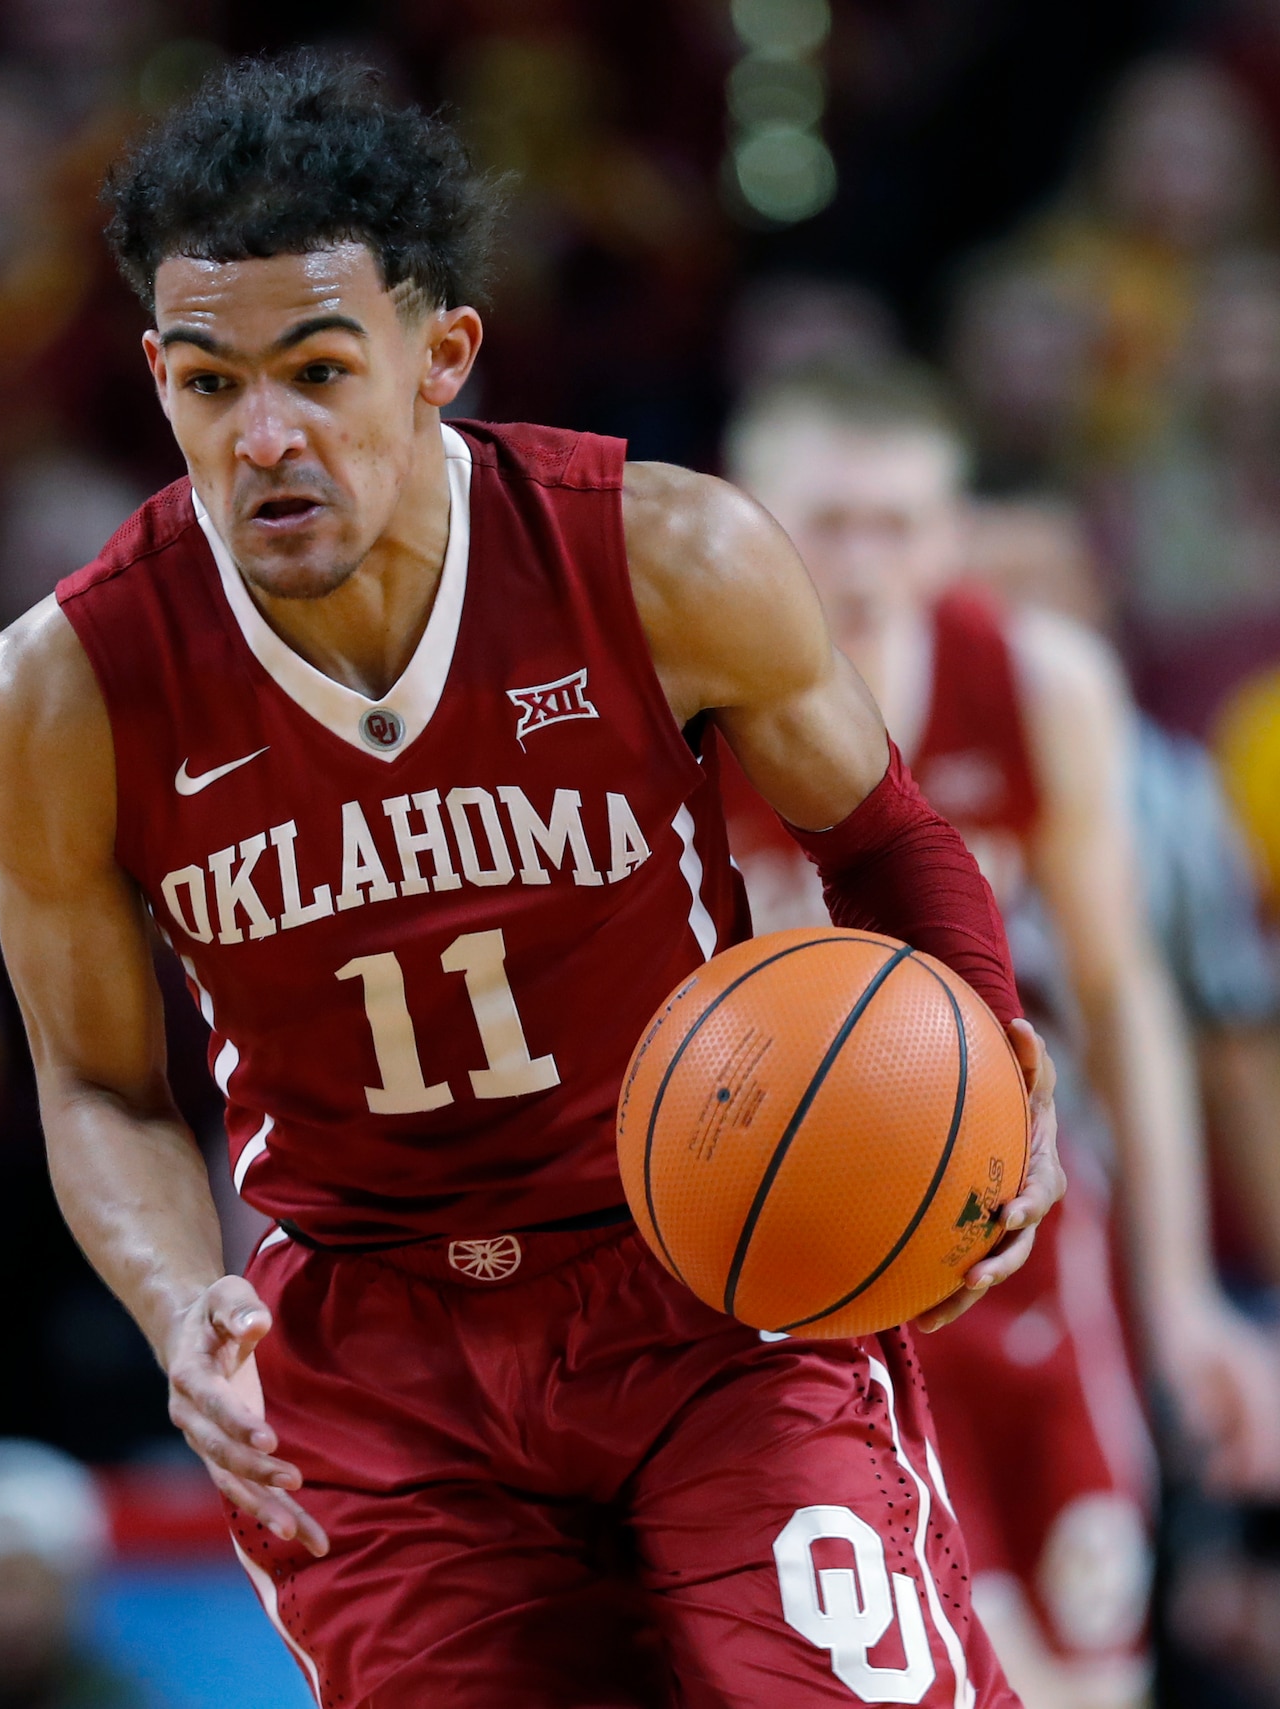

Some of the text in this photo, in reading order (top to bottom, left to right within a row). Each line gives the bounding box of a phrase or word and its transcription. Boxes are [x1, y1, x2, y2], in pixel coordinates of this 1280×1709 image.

[369, 715, 397, 744] OU
[516, 679, 589, 729] XII
[160, 785, 652, 946] OKLAHOMA
[334, 928, 561, 1116] 11
[772, 1504, 936, 1704] OU
